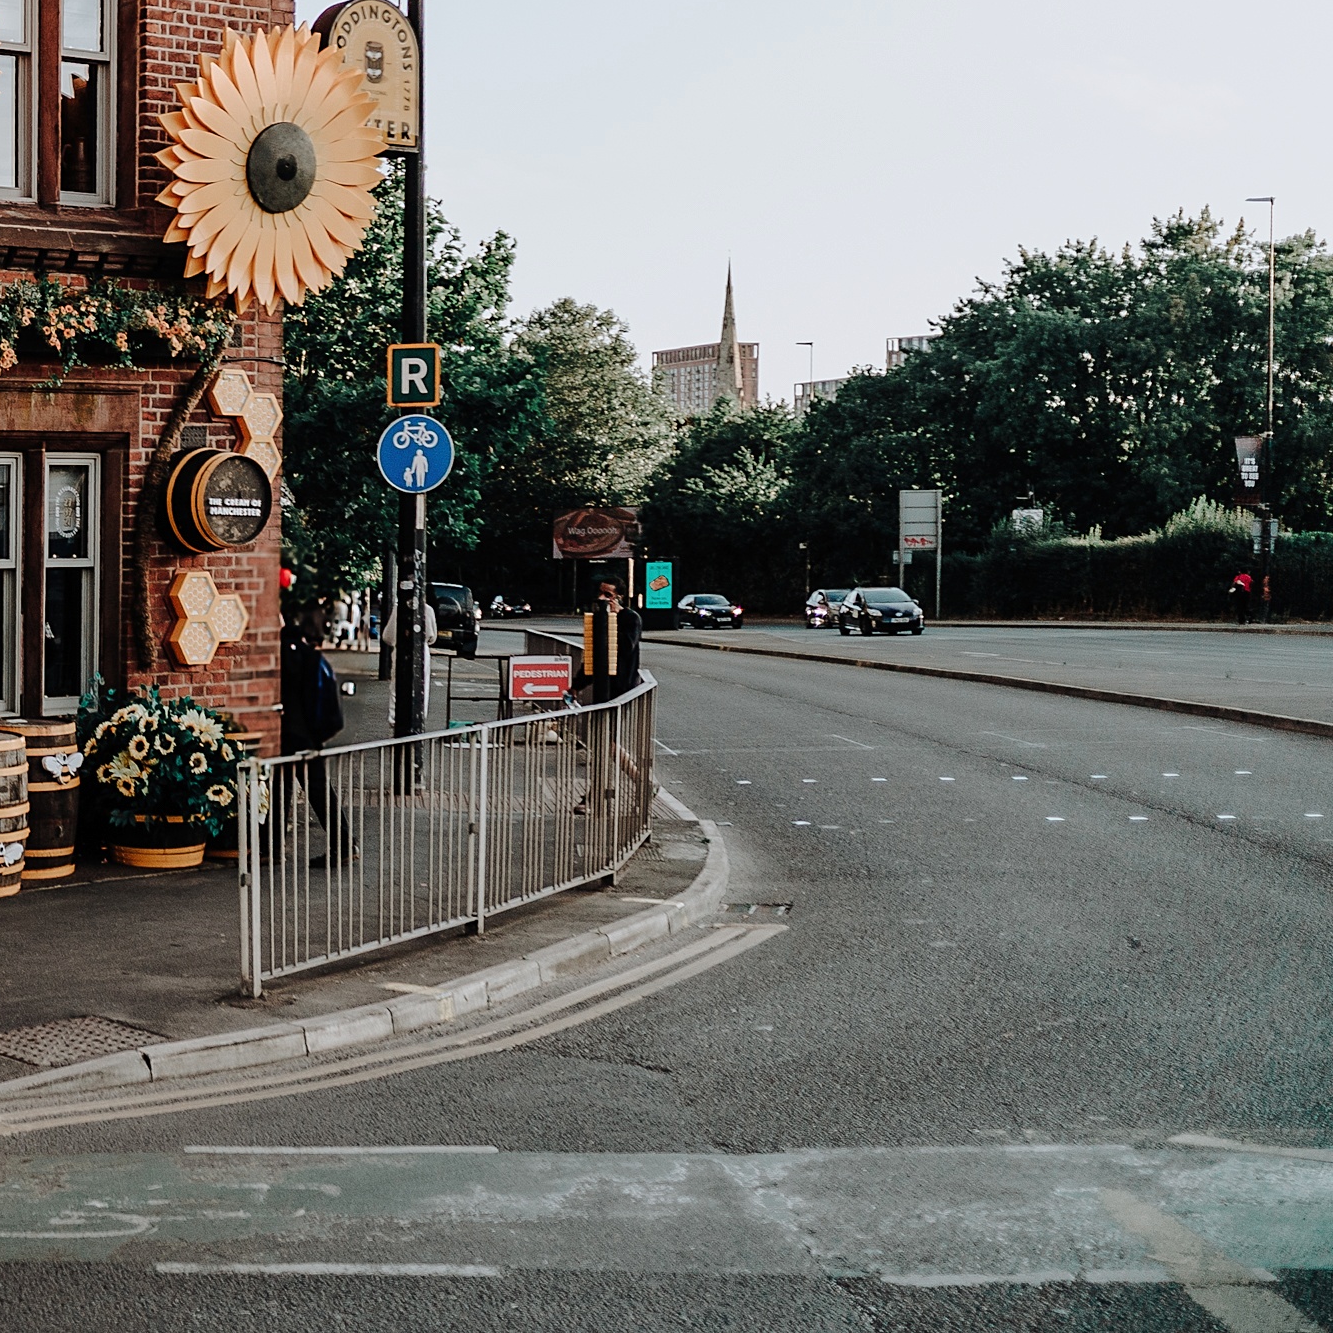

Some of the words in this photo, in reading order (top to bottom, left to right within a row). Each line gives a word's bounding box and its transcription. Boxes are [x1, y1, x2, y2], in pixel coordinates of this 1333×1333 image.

[336, 5, 413, 73] ODDINGTONS
[401, 357, 429, 395] R
[208, 498, 223, 506] THE
[224, 498, 250, 506] CREAM
[209, 507, 262, 516] MANCHESTER
[513, 669, 569, 678] PEDESTRIAN
